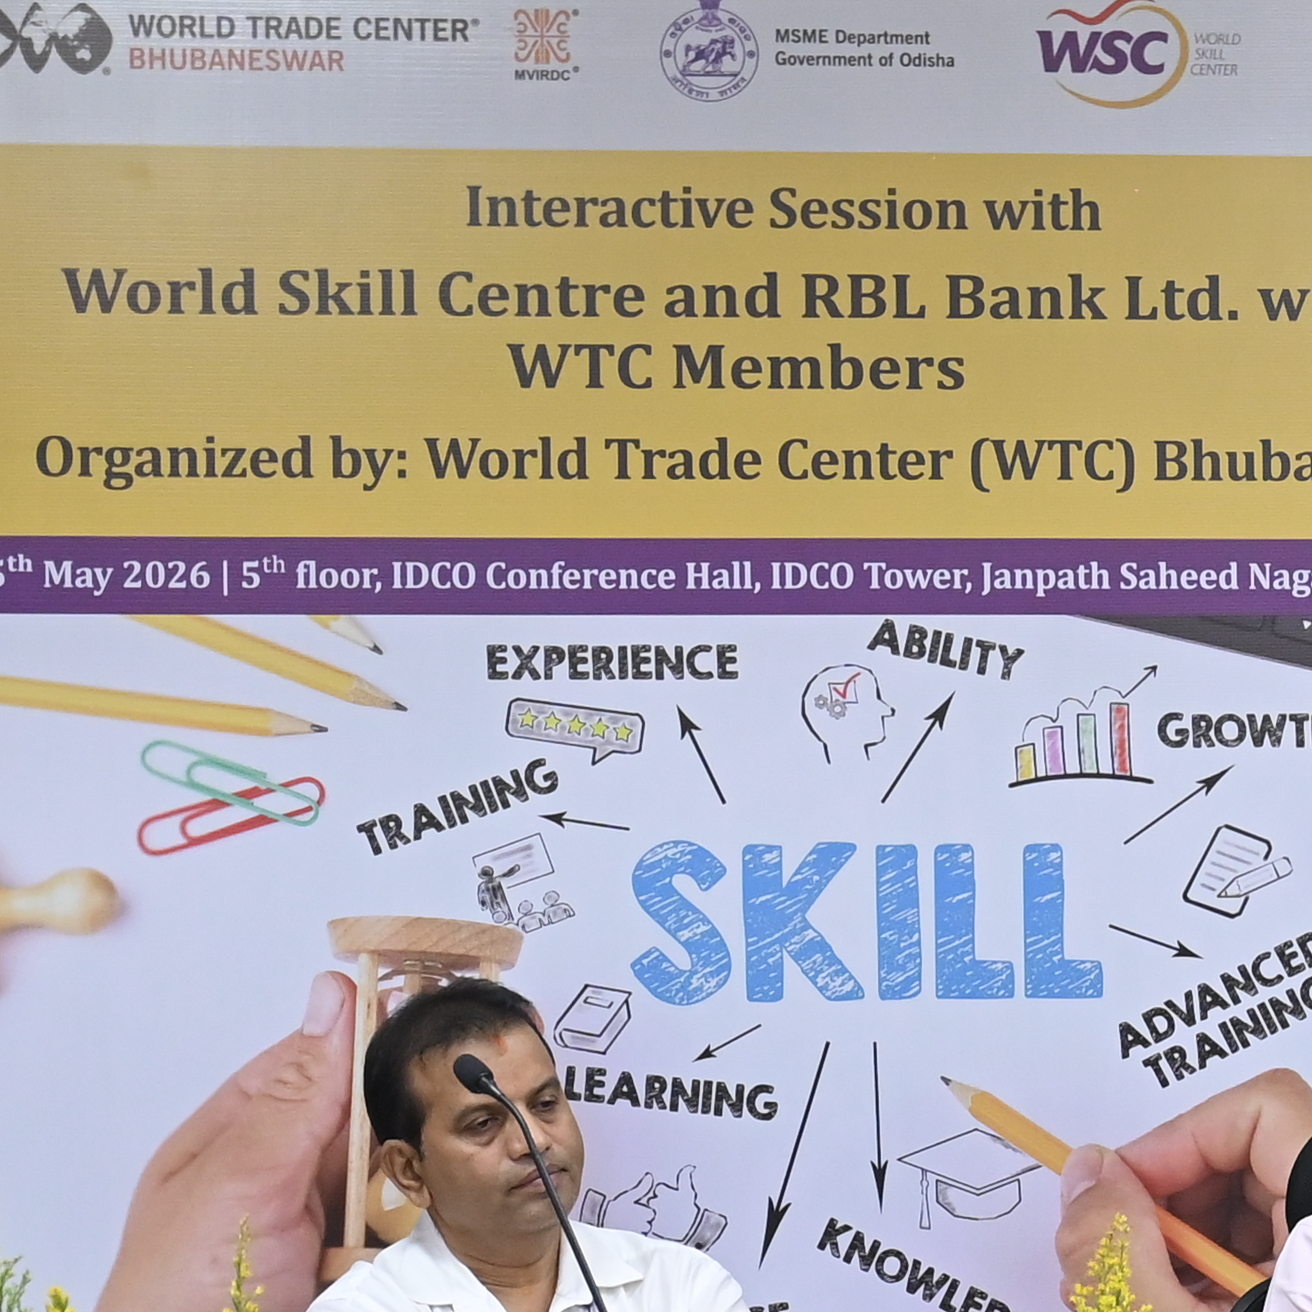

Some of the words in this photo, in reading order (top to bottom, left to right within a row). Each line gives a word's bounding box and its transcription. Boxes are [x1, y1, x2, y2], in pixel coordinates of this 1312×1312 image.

[129, 14, 235, 40] WORLD
[247, 16, 342, 40] TRADE
[775, 29, 829, 43] MSME
[835, 30, 931, 47] Department
[1194, 32, 1242, 46] WORLD
[129, 48, 345, 72] BHUBANESWAR
[775, 51, 874, 67] Government
[879, 52, 894, 67] of
[900, 53, 955, 68] Odisha
[1036, 30, 1169, 75] WSC
[1190, 62, 1239, 77] CENTER
[1194, 47, 1226, 61] SKILL
[466, 186, 754, 229] Interactive
[769, 188, 968, 232] Session
[984, 188, 1102, 233] with
[61, 267, 258, 317] World
[277, 269, 418, 318] Skill
[438, 271, 646, 319] Centre
[664, 272, 780, 320] and
[802, 273, 926, 322] RBL
[946, 274, 1108, 322] Bank
[1124, 275, 1239, 323] Ltd.
[507, 343, 654, 391] WTC
[673, 344, 966, 392] Members
[35, 435, 314, 491] Organized
[330, 436, 408, 492] by:
[425, 437, 589, 481] World
[605, 438, 761, 482] Trade
[777, 438, 954, 483] Center
[970, 438, 1136, 494] (WTC)
[43, 560, 114, 596] May
[123, 560, 211, 589] 2026
[241, 555, 286, 589] 5th
[296, 561, 383, 594] floor,
[392, 562, 477, 590] IDCO
[486, 561, 677, 590] Conference
[684, 561, 762, 595] Hall,
[770, 562, 854, 591] IDCO
[863, 563, 973, 596] Tower,
[981, 563, 1110, 597] Janpath
[1119, 563, 1240, 591] Saheed
[486, 644, 739, 681] EXPERIENCE
[867, 619, 1025, 680] ABILITY
[356, 758, 559, 856] TRAINING
[630, 840, 1104, 1006] SKILL
[564, 1065, 779, 1122] LEARNING
